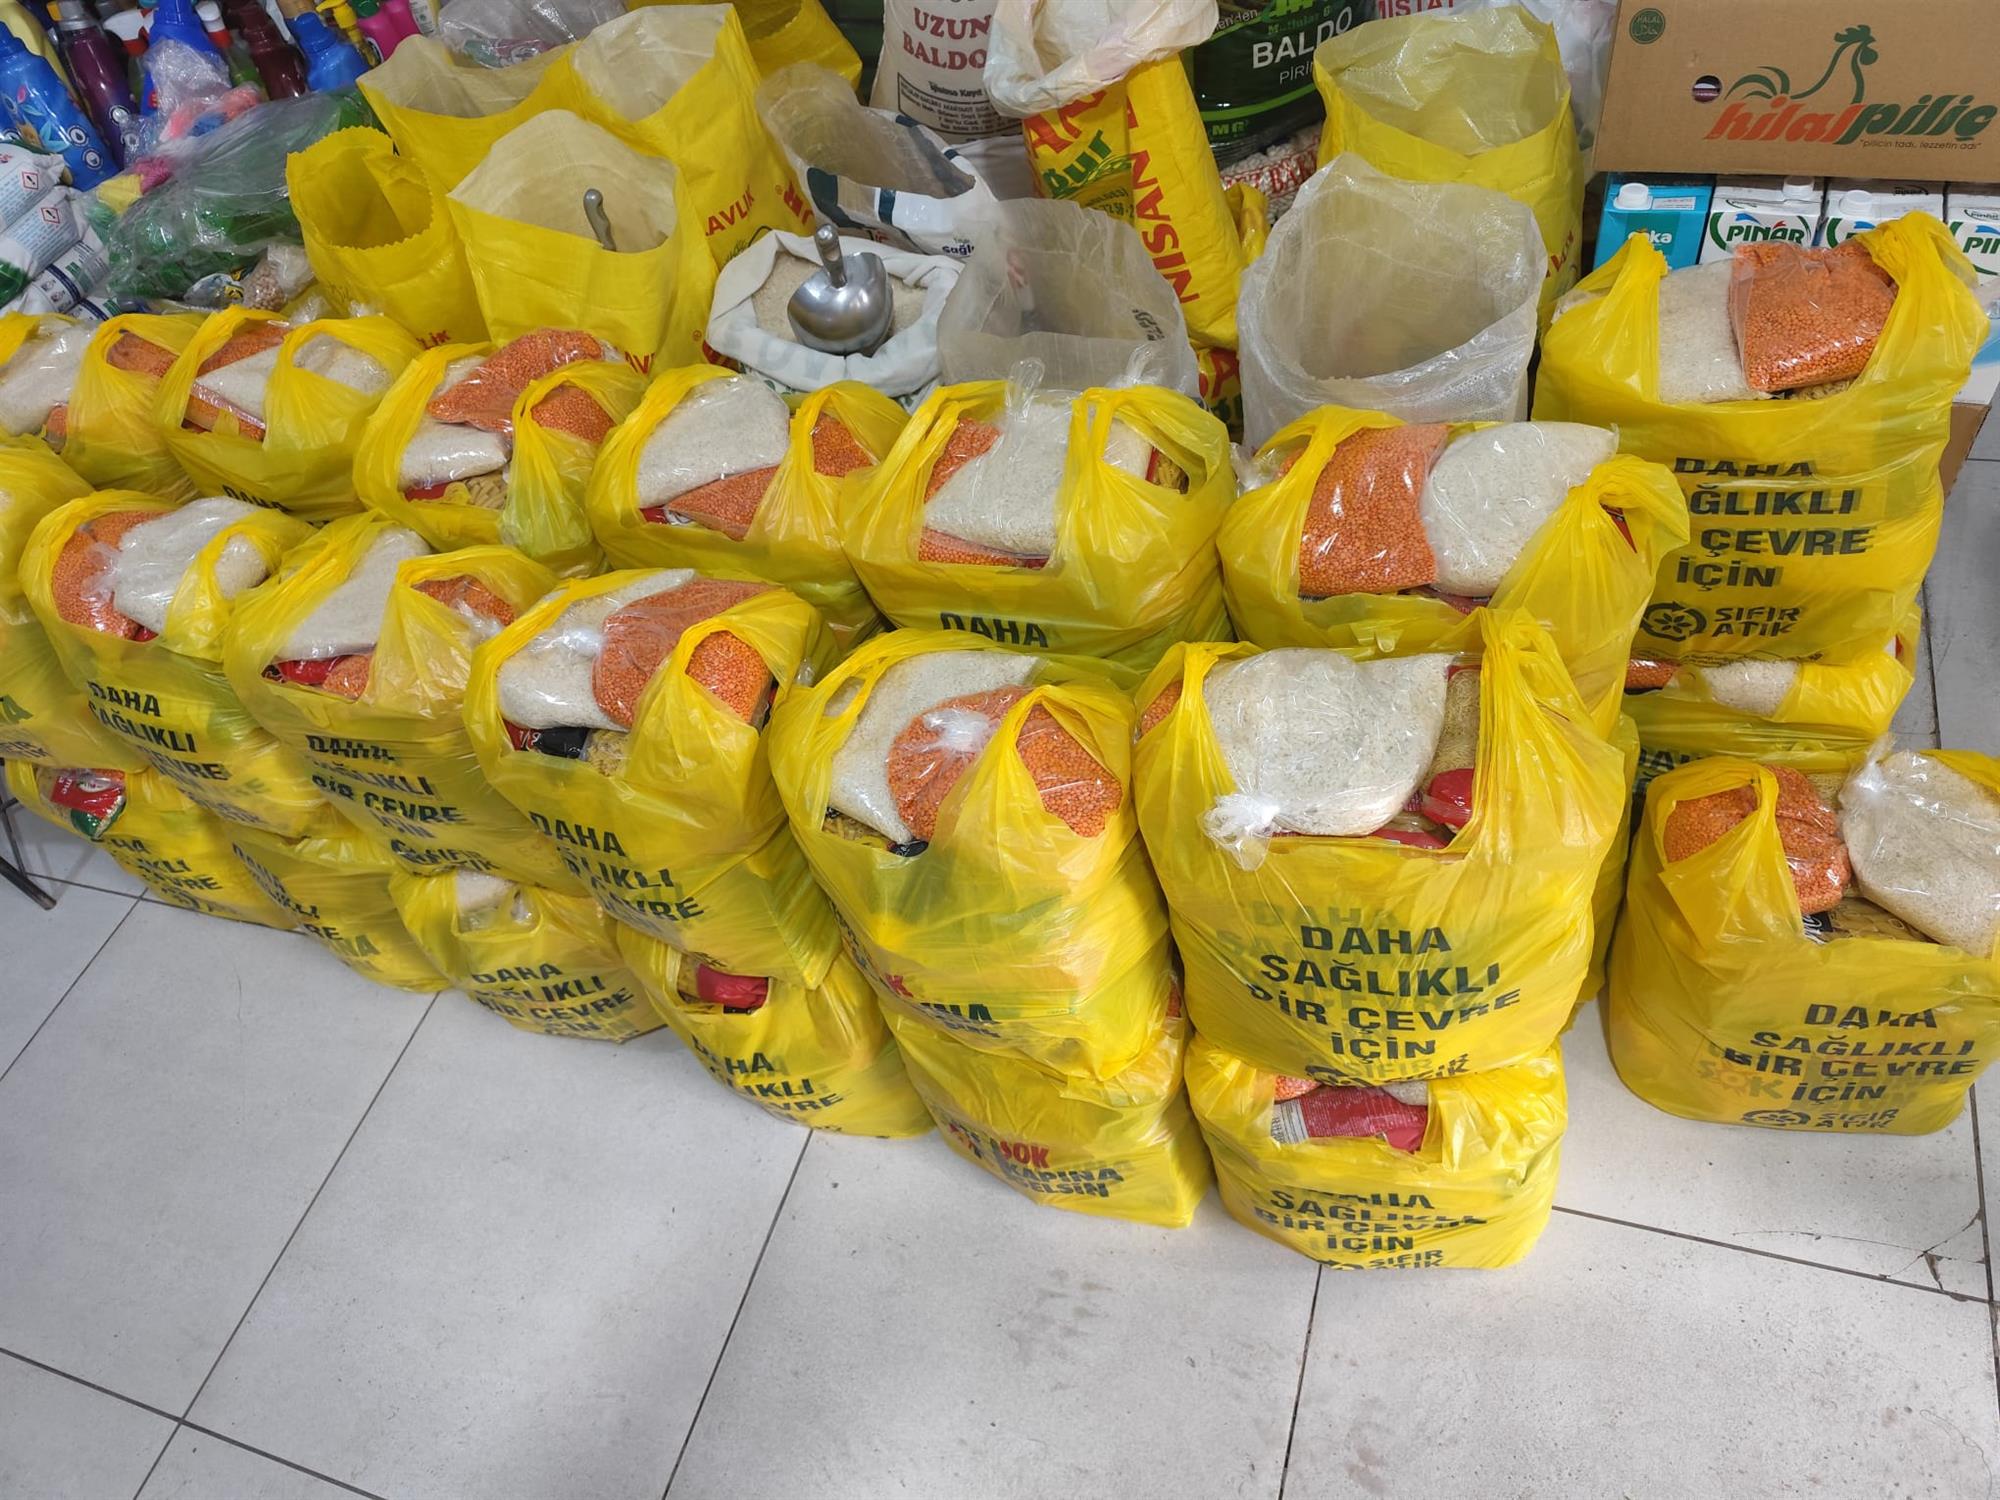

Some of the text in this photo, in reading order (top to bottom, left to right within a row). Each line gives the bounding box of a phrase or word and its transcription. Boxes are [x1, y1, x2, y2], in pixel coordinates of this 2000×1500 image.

[914, 7, 992, 39] UZUN
[1252, 6, 1352, 69] BALDO
[903, 30, 987, 70] BALDO
[1726, 225, 1805, 245] PINAR
[1674, 456, 1815, 478] DAHA
[1689, 484, 1857, 516] ĞLIKLI
[1701, 528, 1872, 558] ÇEVRE
[1676, 556, 1777, 592] İÇİN
[1712, 620, 1795, 638] ATIK
[1715, 606, 1801, 622] SIFIR
[940, 611, 1049, 649] DAHA
[87, 679, 162, 718] DAHA
[528, 810, 629, 858] DAHA
[1301, 925, 1453, 956] DAHA
[471, 962, 563, 984] DAHA
[1259, 953, 1500, 998] SAĞLIKLI
[528, 987, 635, 1021] ÇEVRE
[1347, 988, 1522, 1036] ÇEVRE
[1803, 1003, 1938, 1029] DAHA
[1330, 1031, 1437, 1065] İÇİN
[1750, 1030, 1976, 1057] SAĞLIKLI
[1820, 1058, 1981, 1082] ÇEVRE
[1791, 1081, 1888, 1105] İÇİN
[1254, 1206, 1325, 1231] BİR
[1327, 1234, 1414, 1254] İÇİN
[1368, 1249, 1444, 1267] SIFIR
